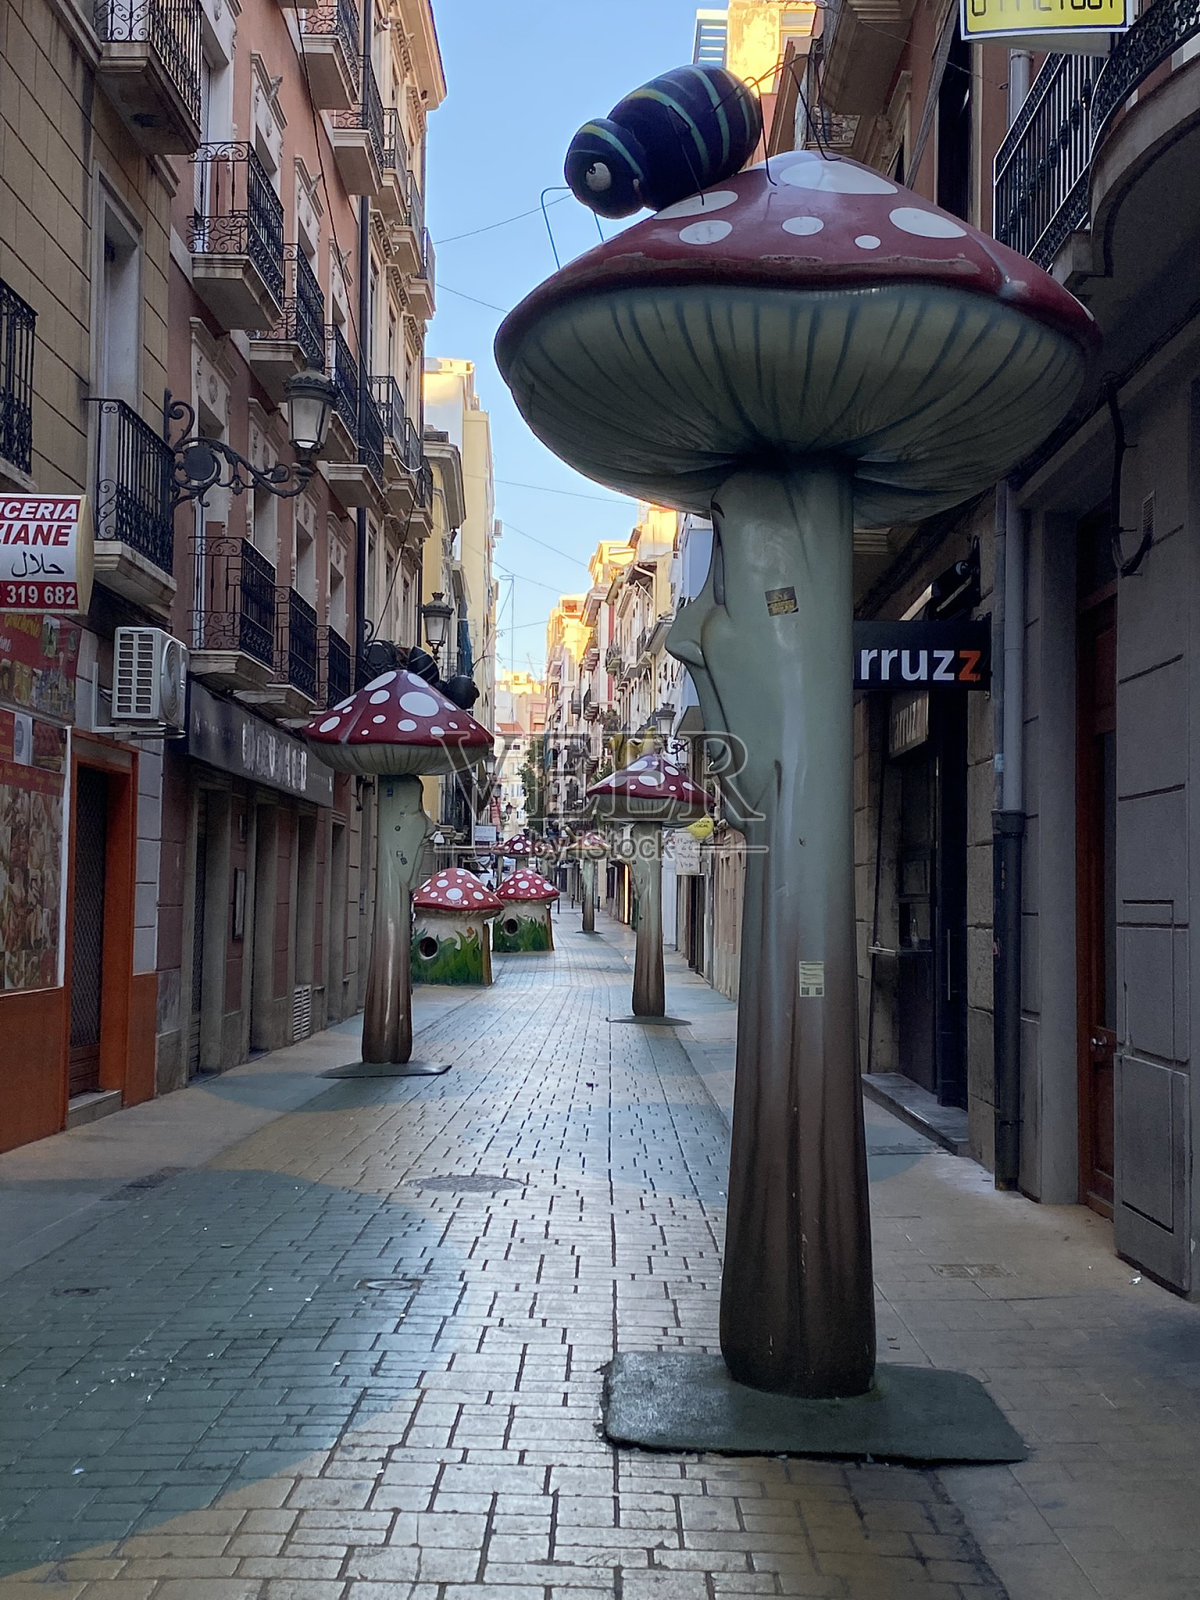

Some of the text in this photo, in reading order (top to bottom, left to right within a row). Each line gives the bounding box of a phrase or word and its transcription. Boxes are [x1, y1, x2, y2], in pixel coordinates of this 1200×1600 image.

[11, 551, 64, 577] حلال
[7, 585, 76, 605] 319 682
[855, 649, 981, 681] rruzz
